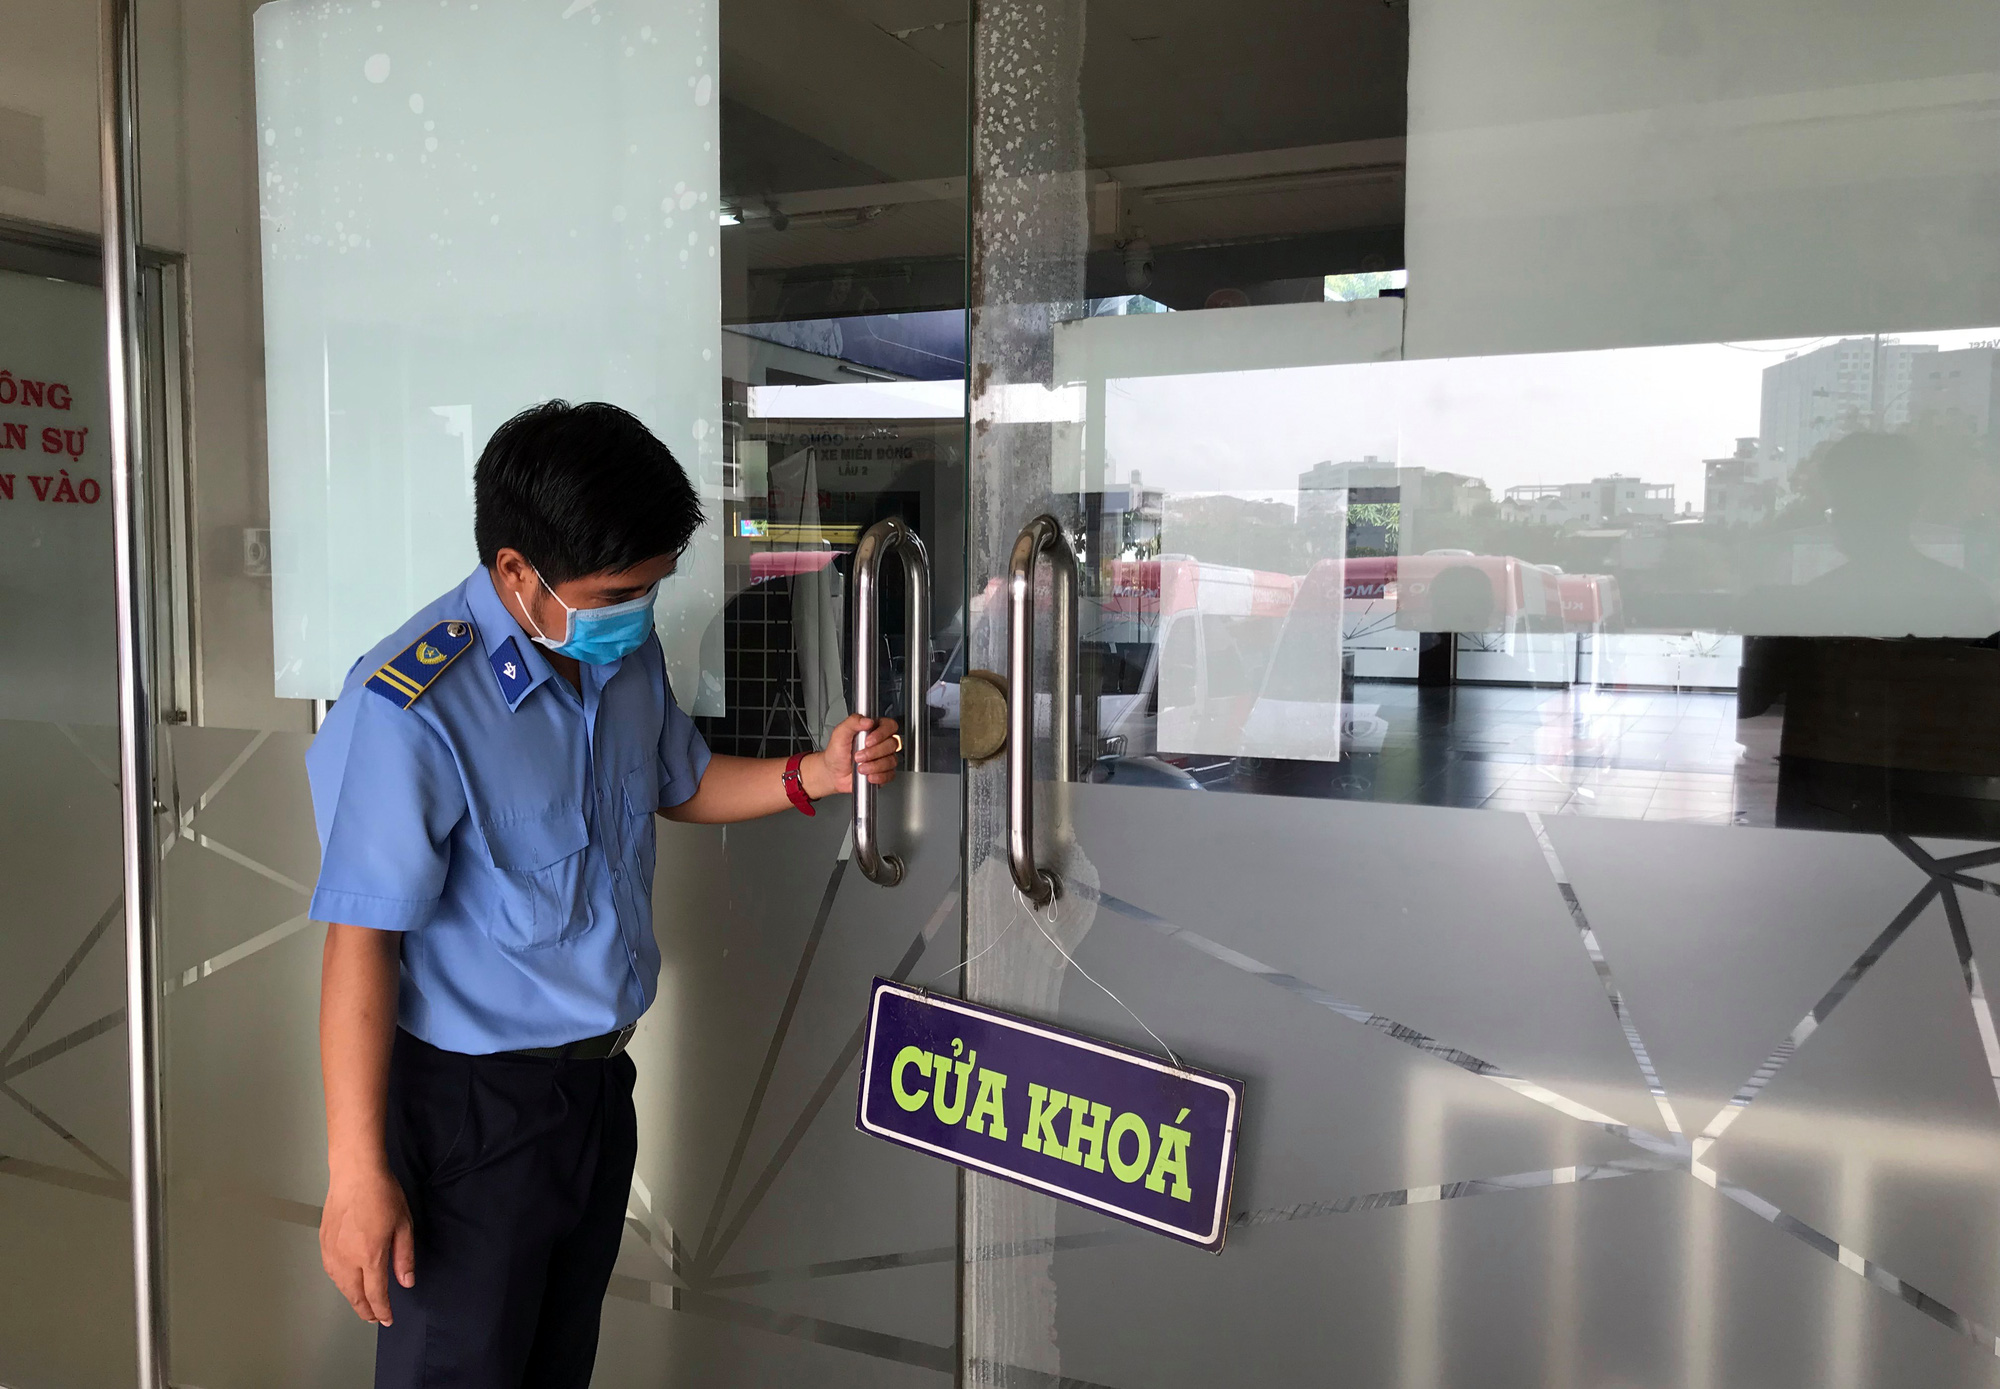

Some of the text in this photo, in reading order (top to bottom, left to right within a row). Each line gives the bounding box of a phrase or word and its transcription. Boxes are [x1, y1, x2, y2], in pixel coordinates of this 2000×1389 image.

[0, 422, 89, 462] N SỰ
[820, 448, 838, 461] XE
[840, 442, 872, 461] MIỀN
[27, 468, 101, 504] VÀO
[861, 466, 868, 476] 2
[891, 1037, 1192, 1203] CỬA KHOÁ
